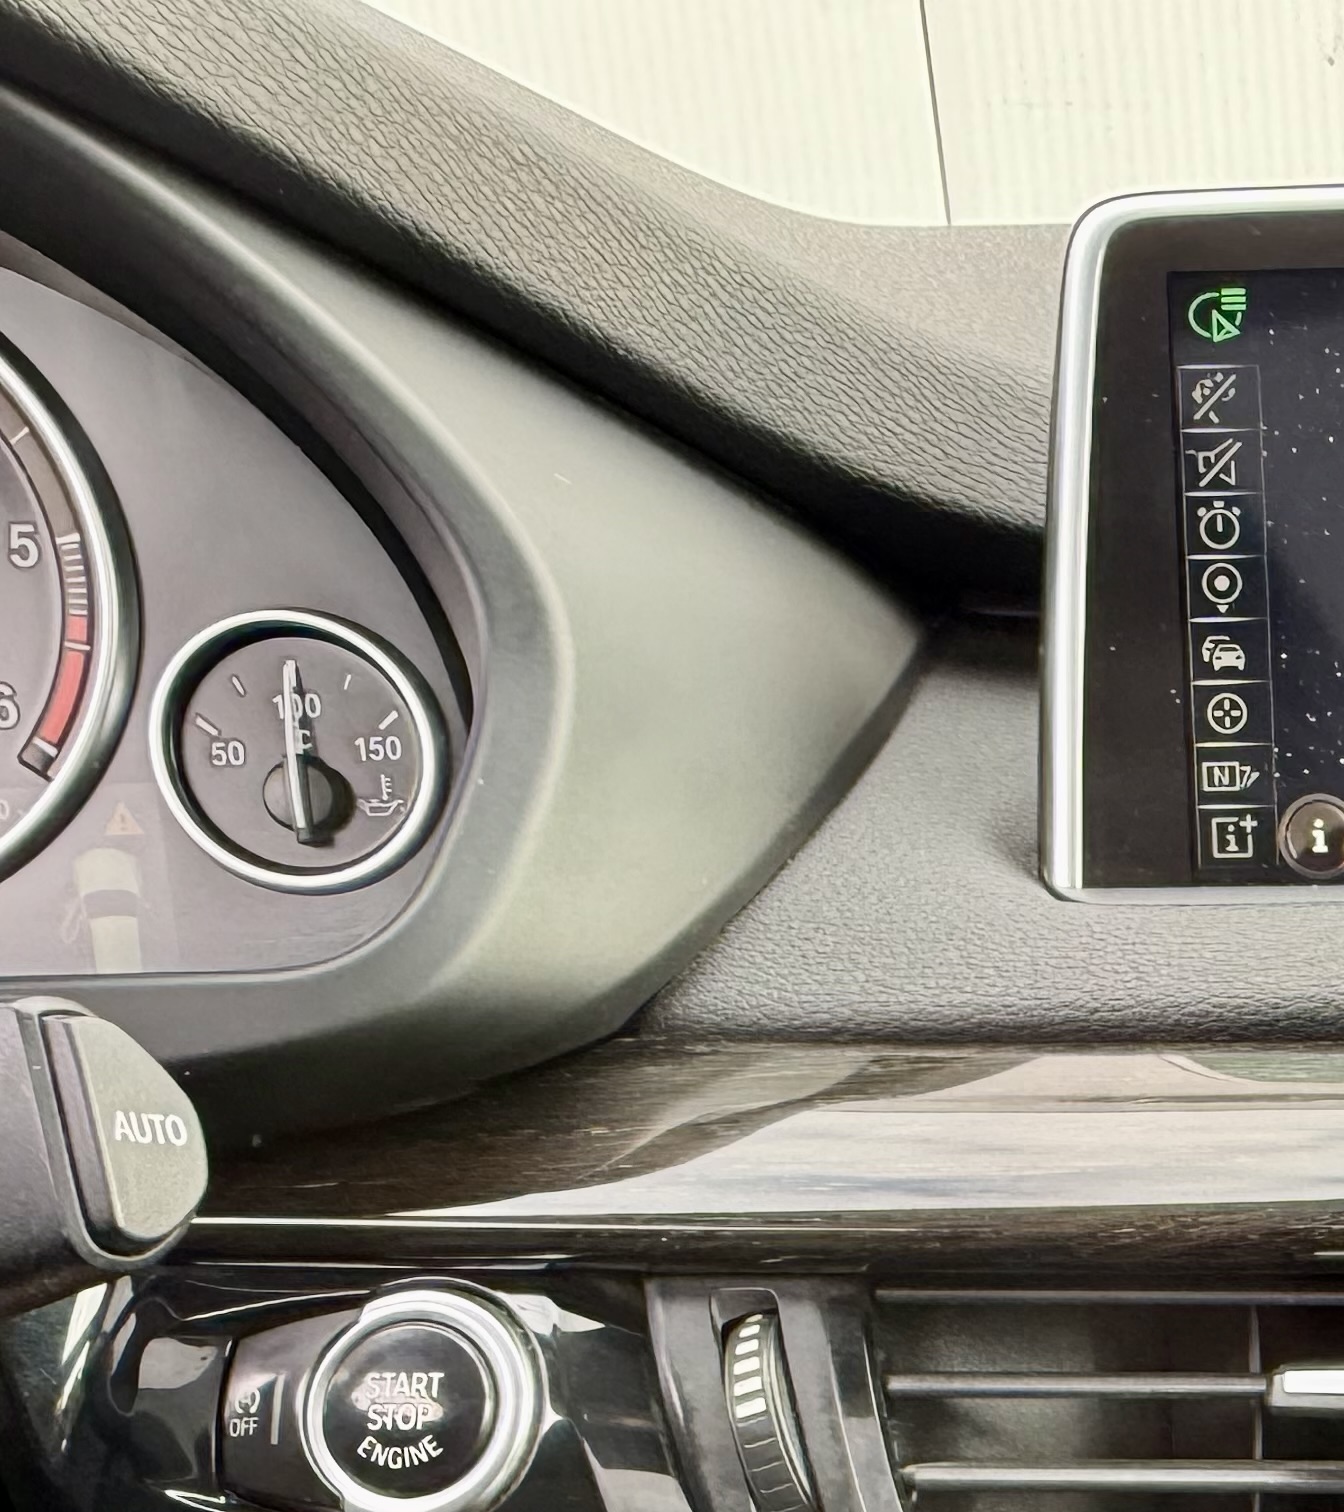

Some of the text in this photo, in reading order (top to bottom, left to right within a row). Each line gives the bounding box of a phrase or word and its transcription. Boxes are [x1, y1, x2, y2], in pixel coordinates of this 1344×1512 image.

[8, 522, 39, 568] 5
[211, 740, 246, 766] 50
[354, 735, 402, 761] 150
[114, 1110, 188, 1146] AUTO
[365, 1371, 445, 1399] START
[229, 1417, 259, 1437] OFF
[366, 1403, 432, 1431] STOP
[356, 1434, 444, 1469] ENGINE
